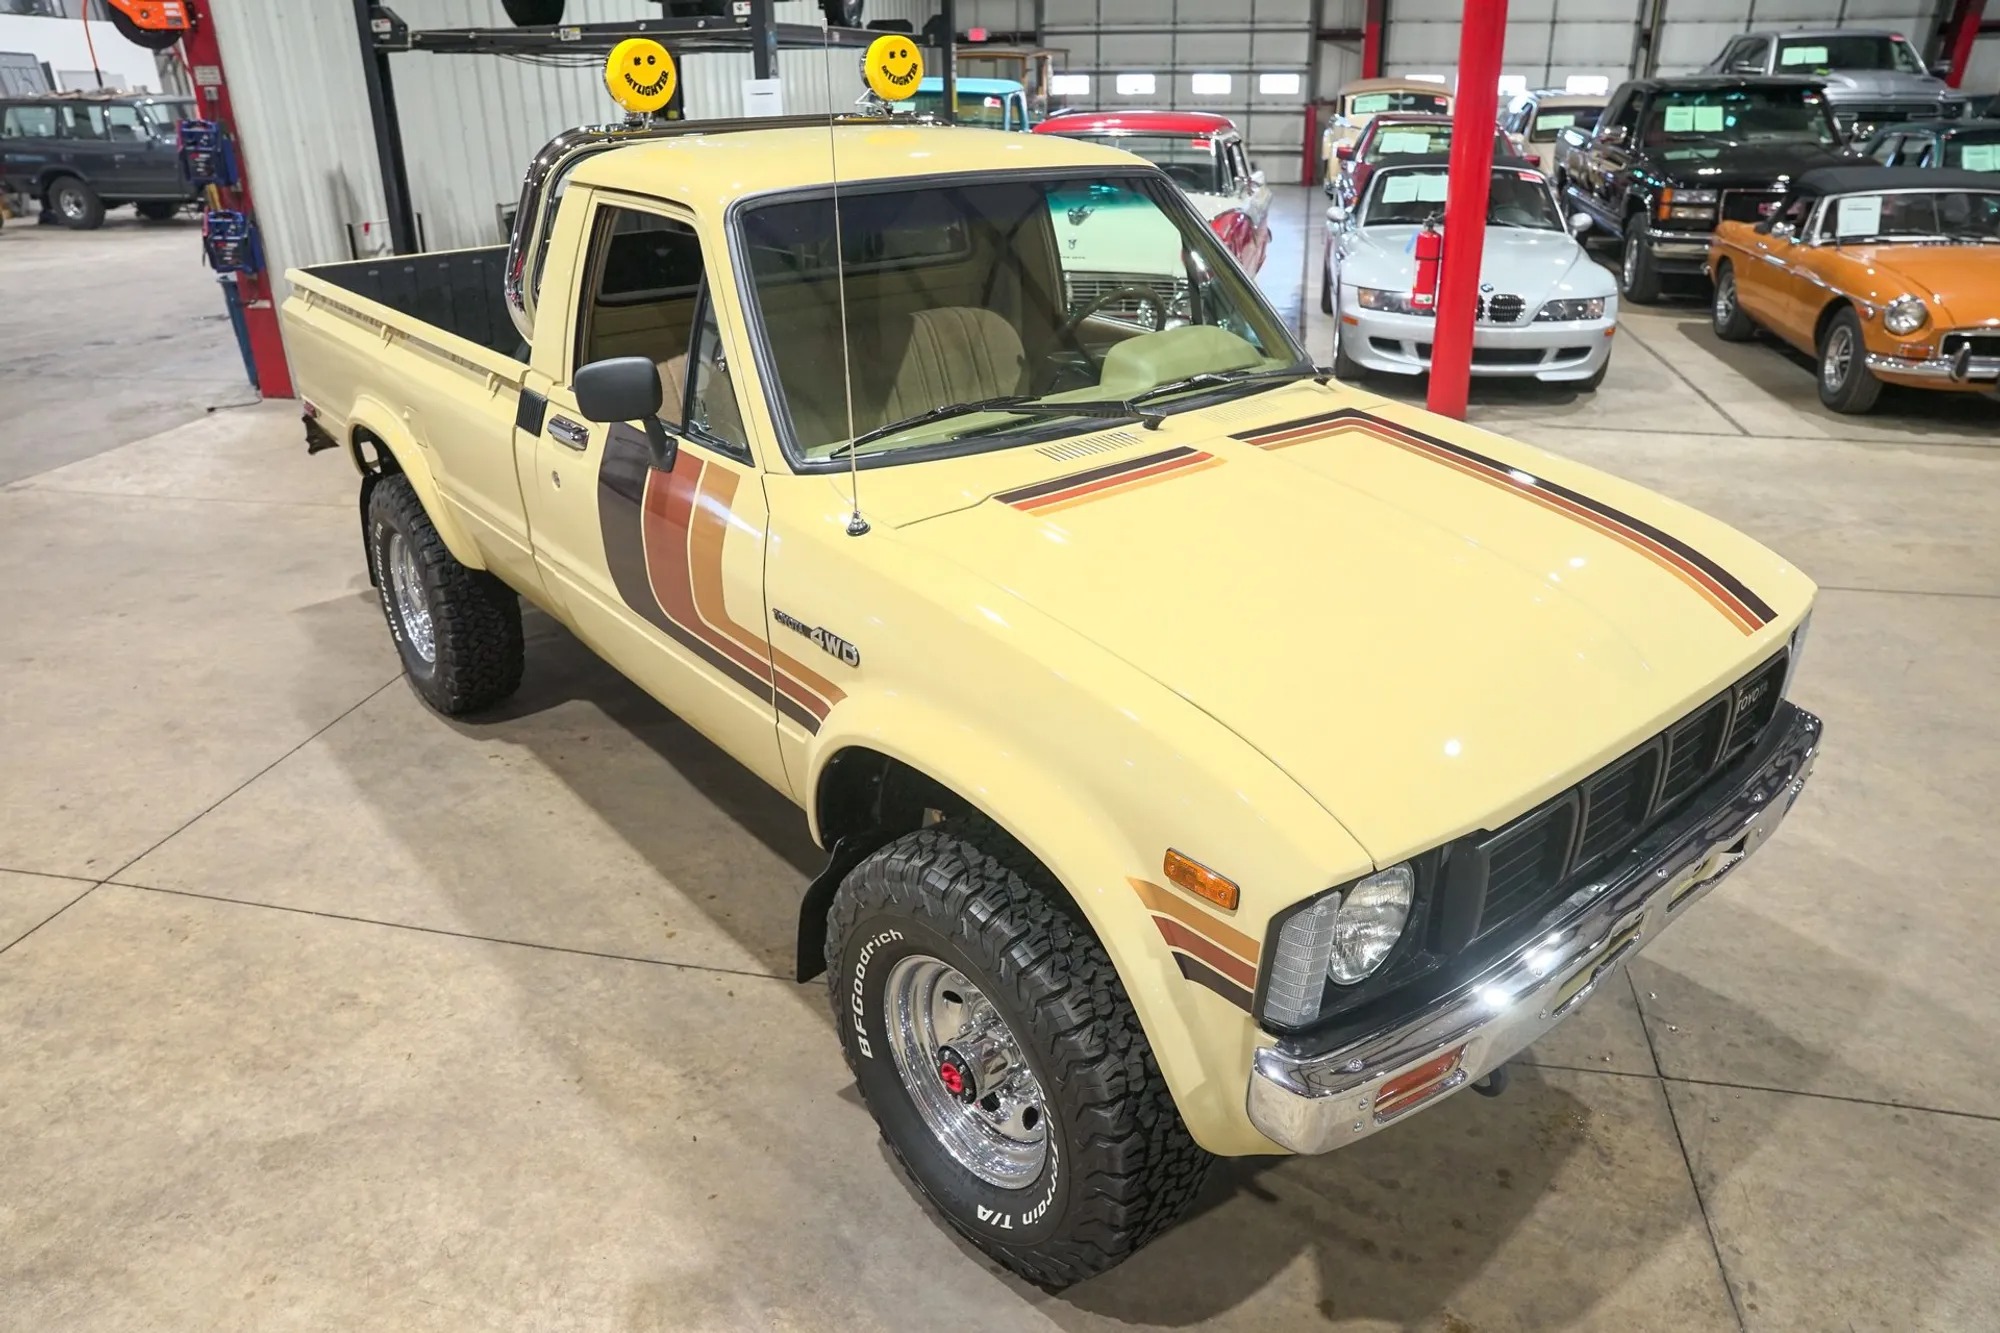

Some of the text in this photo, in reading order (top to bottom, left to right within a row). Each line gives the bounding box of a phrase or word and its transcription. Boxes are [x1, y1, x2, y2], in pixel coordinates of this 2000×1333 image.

[624, 70, 669, 96] DAYLIGHTER
[881, 62, 919, 86] DAYLIGHTER
[810, 627, 859, 668] 4WD
[852, 929, 904, 1058] BFGoodrich
[977, 1204, 1013, 1229] T/A
